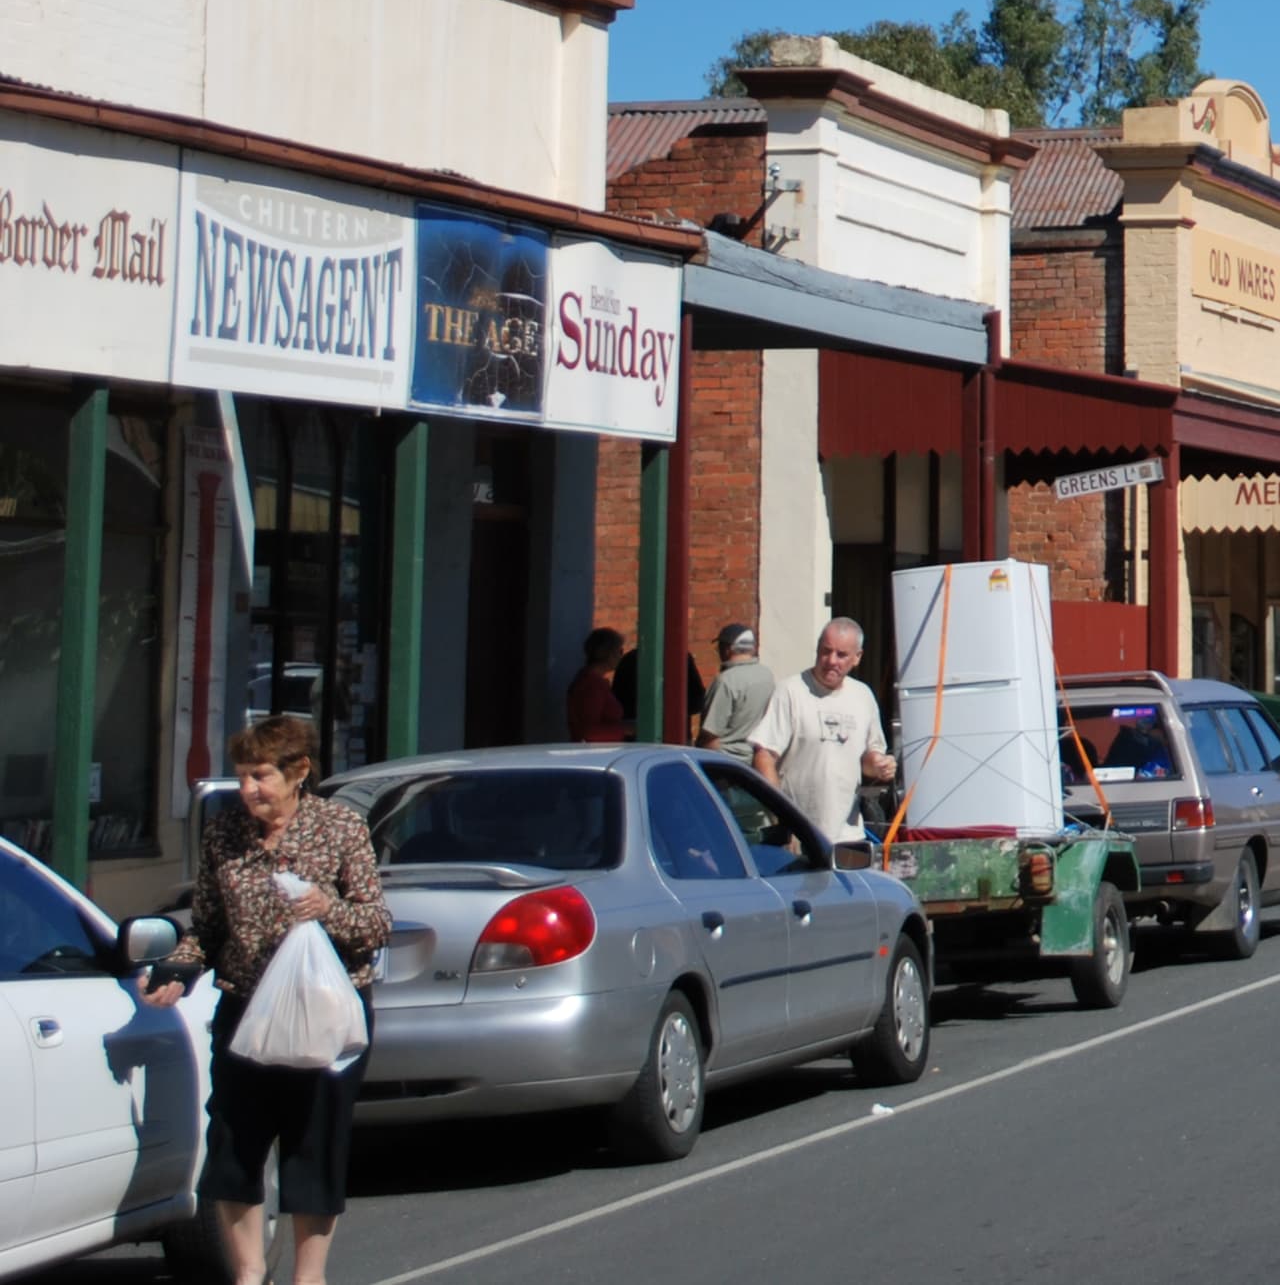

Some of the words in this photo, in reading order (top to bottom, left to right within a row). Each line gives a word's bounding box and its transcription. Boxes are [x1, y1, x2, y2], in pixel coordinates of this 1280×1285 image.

[239, 194, 369, 242] CHILTERN
[92, 208, 167, 288] Mail
[1209, 248, 1231, 288] OLD
[1237, 257, 1277, 303] WARES
[190, 209, 403, 362] NEWSAGENT
[424, 303, 480, 347] THE
[484, 316, 539, 357] AGE
[556, 290, 675, 407] Sunday
[1059, 470, 1118, 496] GREENS
